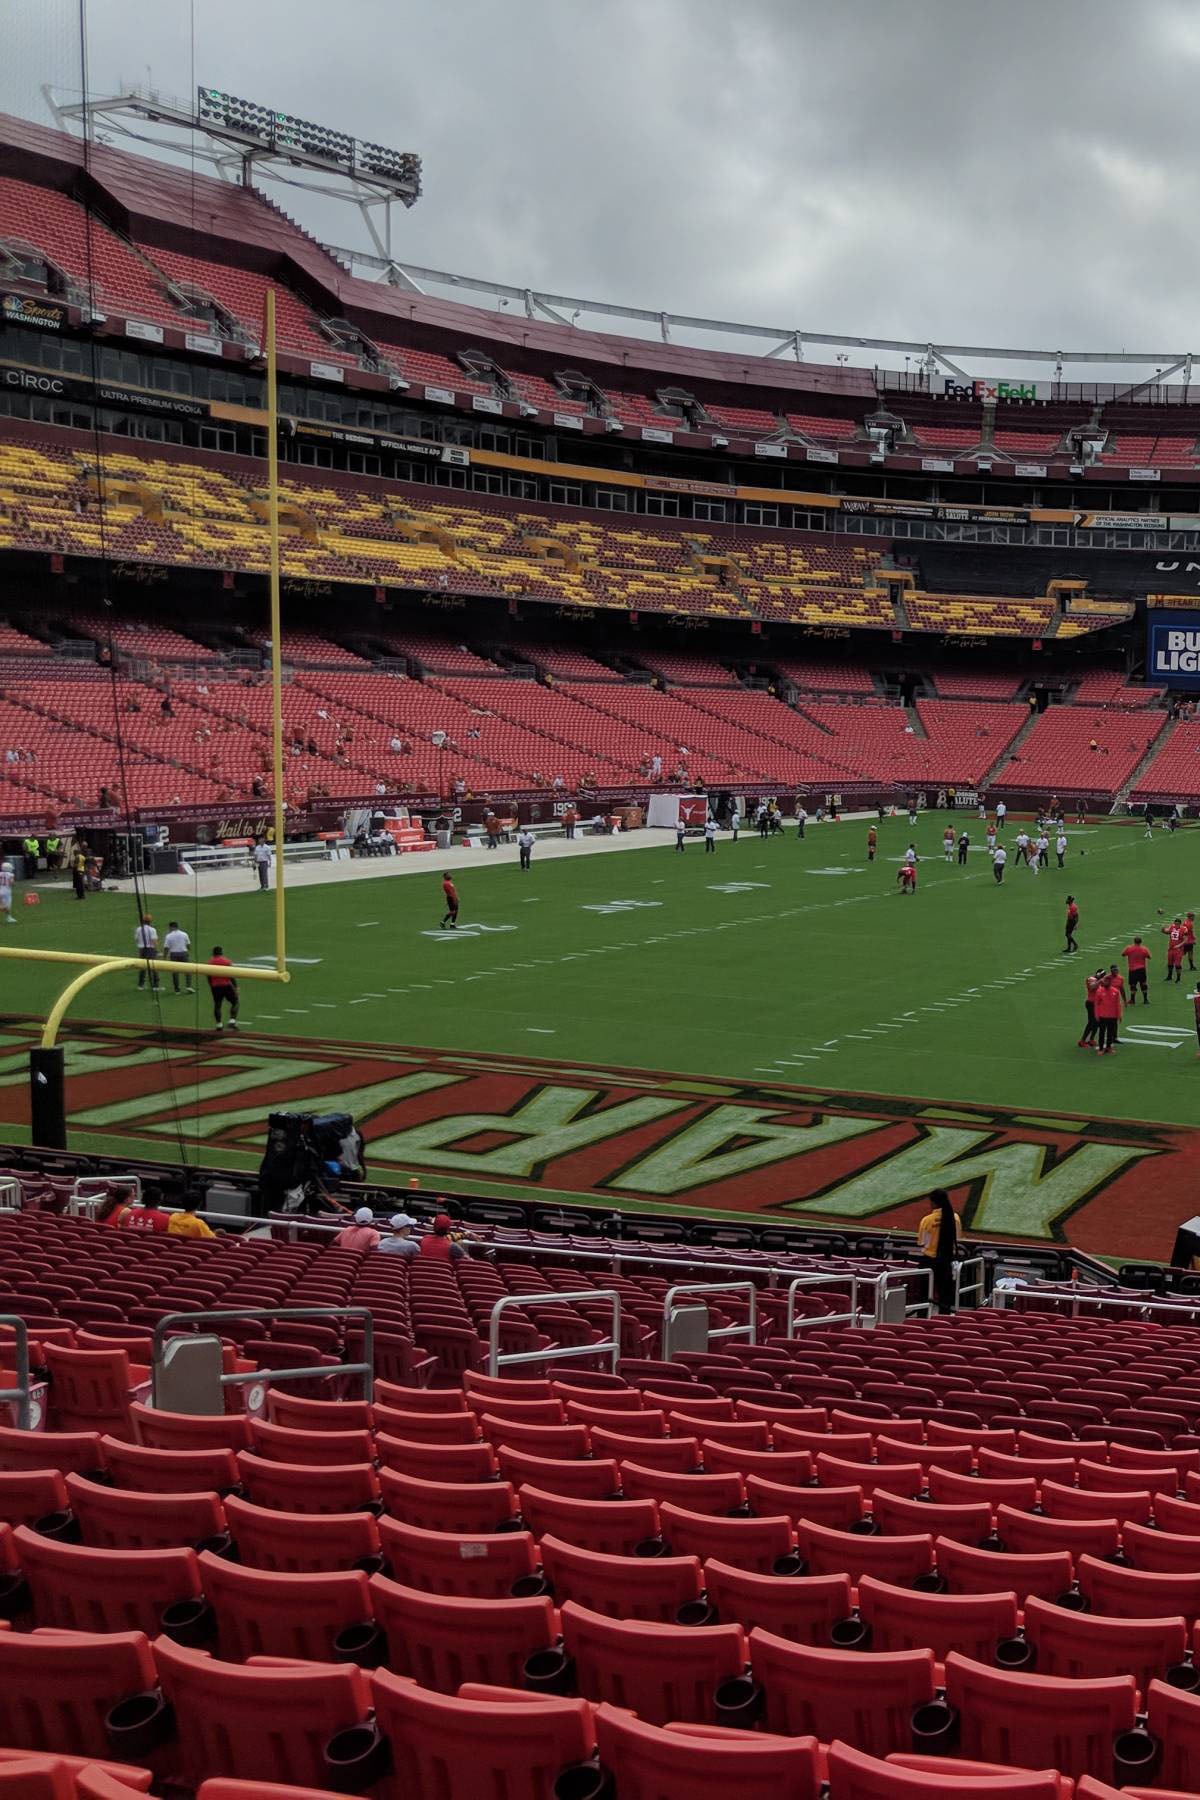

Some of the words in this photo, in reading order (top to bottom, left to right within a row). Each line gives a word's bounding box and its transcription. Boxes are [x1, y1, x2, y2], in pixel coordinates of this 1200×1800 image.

[6, 311, 60, 329] WASHINGTON
[21, 301, 64, 320] Sports
[944, 379, 1036, 400] FedExField
[100, 389, 129, 402] ULTRA
[130, 395, 172, 409] PREMIUM
[173, 402, 202, 415] VODKA
[380, 439, 406, 450] OFFICIAL
[429, 447, 440, 456] APP
[216, 819, 242, 839] Hail
[243, 824, 254, 836] to
[1116, 1025, 1198, 1049] 10
